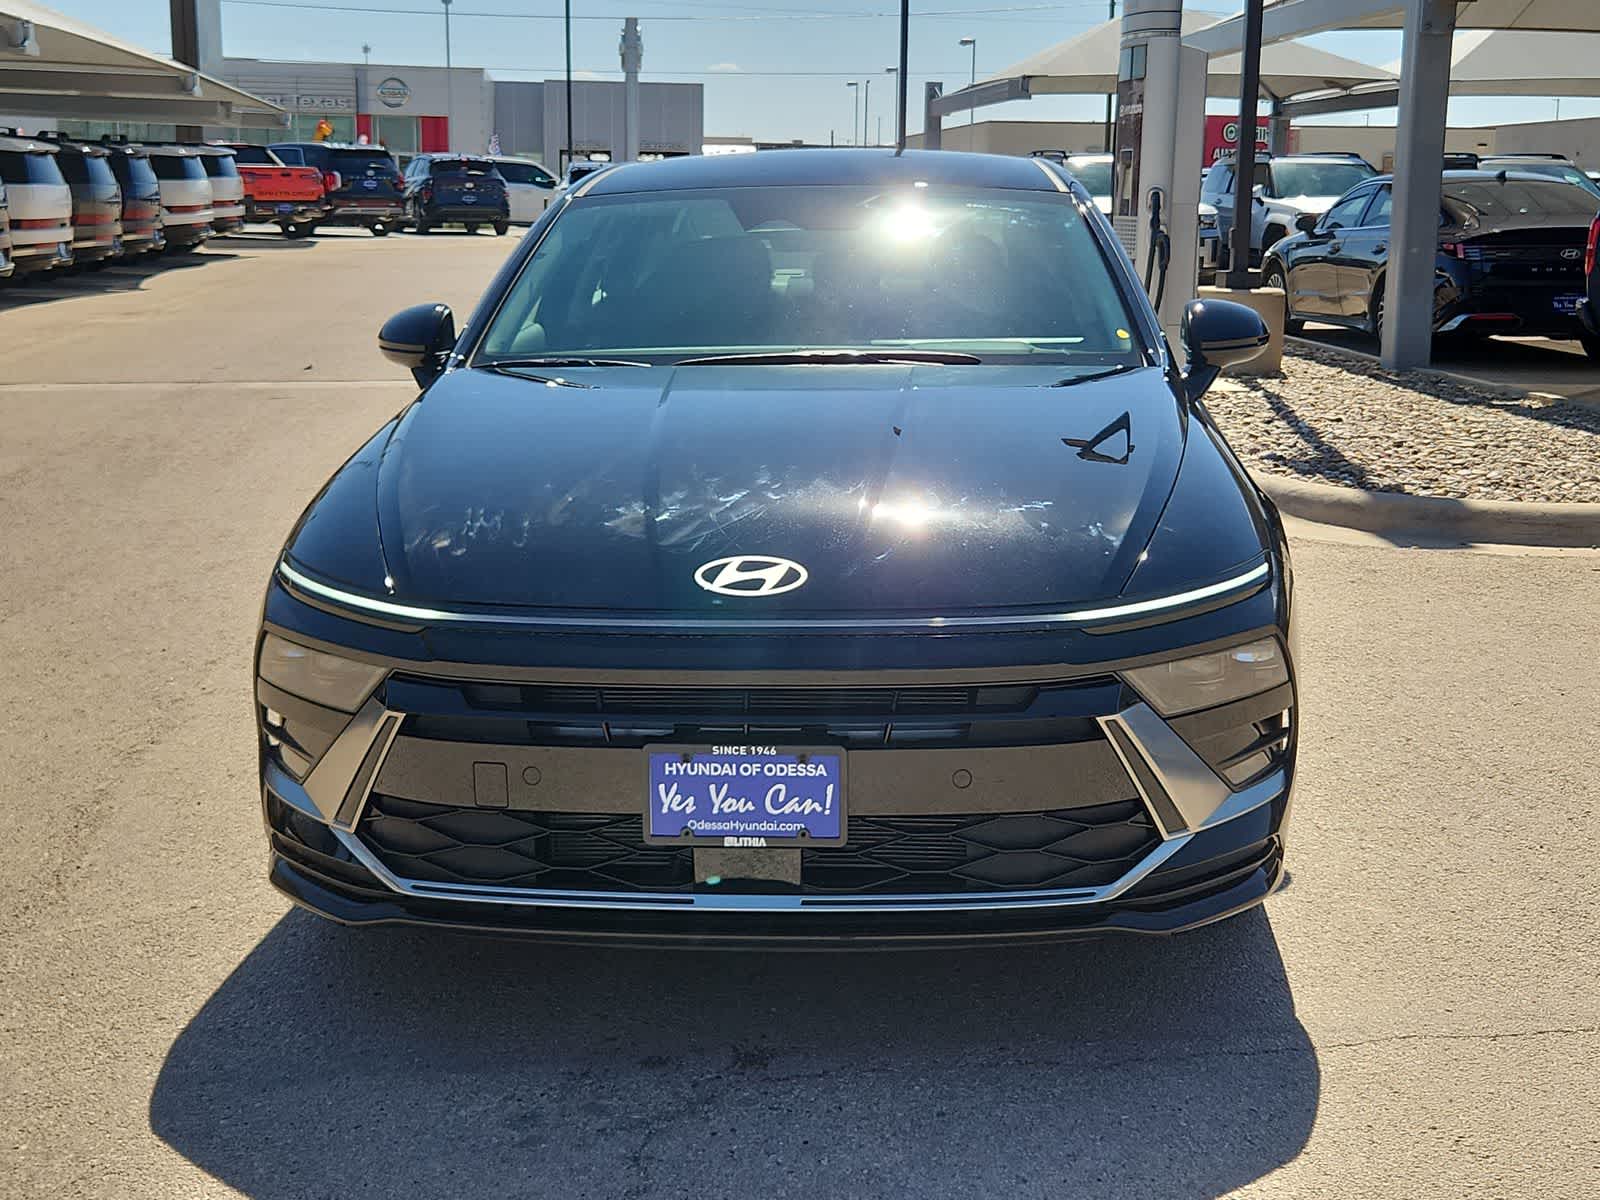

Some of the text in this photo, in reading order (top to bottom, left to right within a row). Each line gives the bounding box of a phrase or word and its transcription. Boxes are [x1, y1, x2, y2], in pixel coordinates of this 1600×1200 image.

[712, 745, 777, 756] SINCE 1946
[664, 763, 828, 777] HYUNDAI OF ODESSA
[658, 782, 834, 816] Yes You Can!
[687, 819, 805, 832] OdessaHyundai.com
[734, 836, 767, 847] LITHIA
